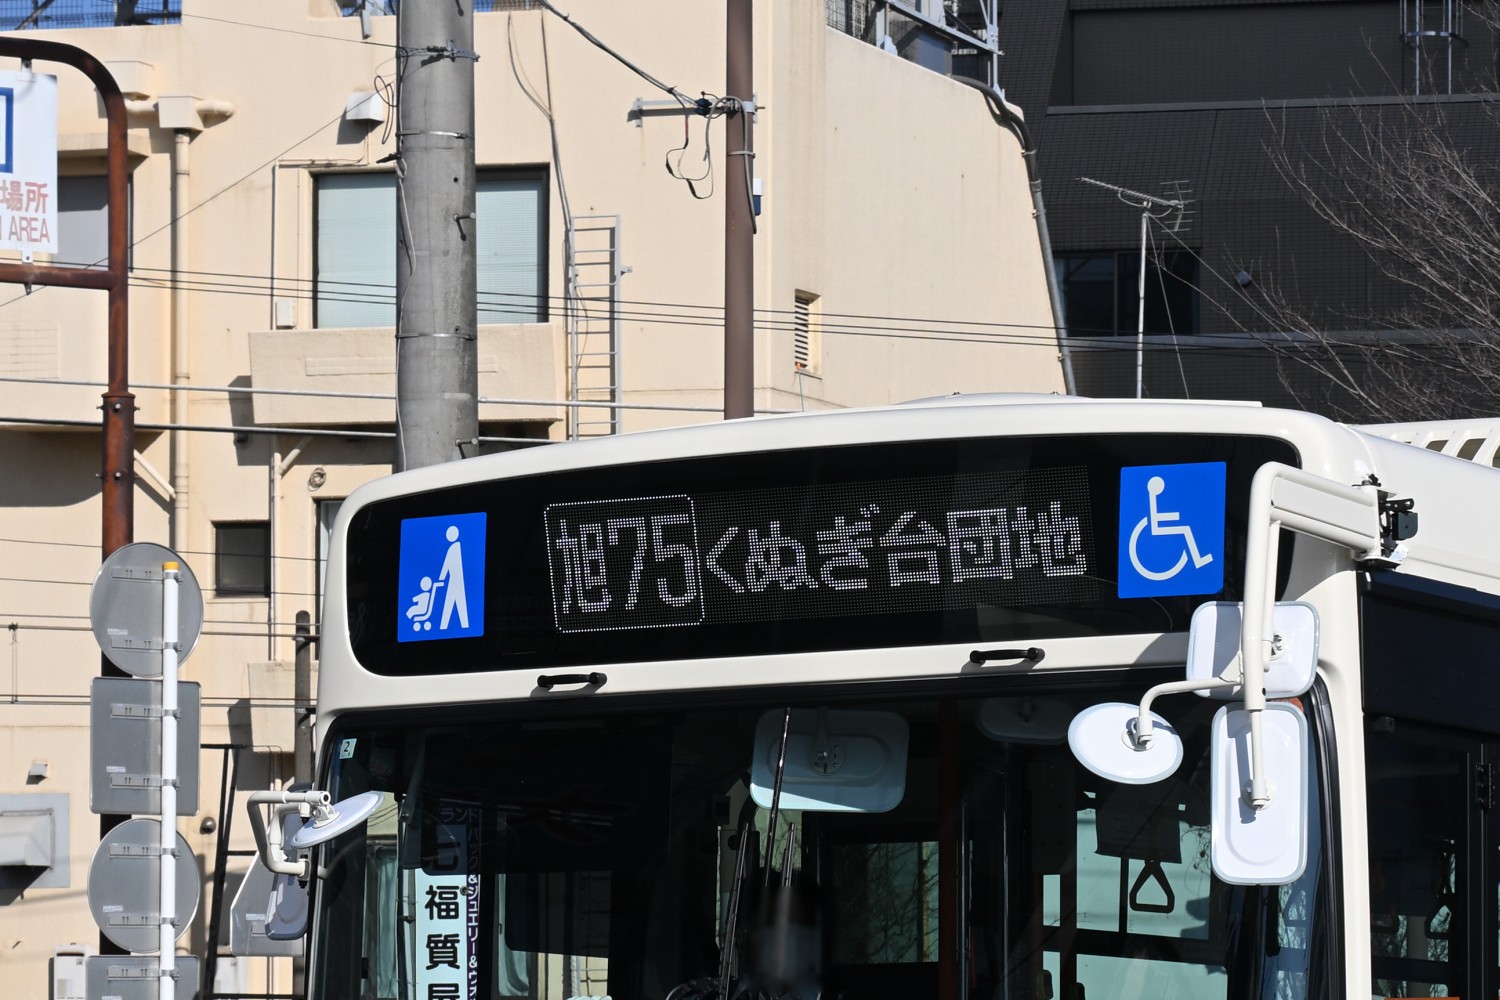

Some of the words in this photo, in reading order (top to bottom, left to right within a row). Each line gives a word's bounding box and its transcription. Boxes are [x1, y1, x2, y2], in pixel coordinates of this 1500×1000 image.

[9, 216, 50, 243] AREA
[556, 513, 698, 614] 旭75
[705, 501, 1088, 593] くぬぎ台団地
